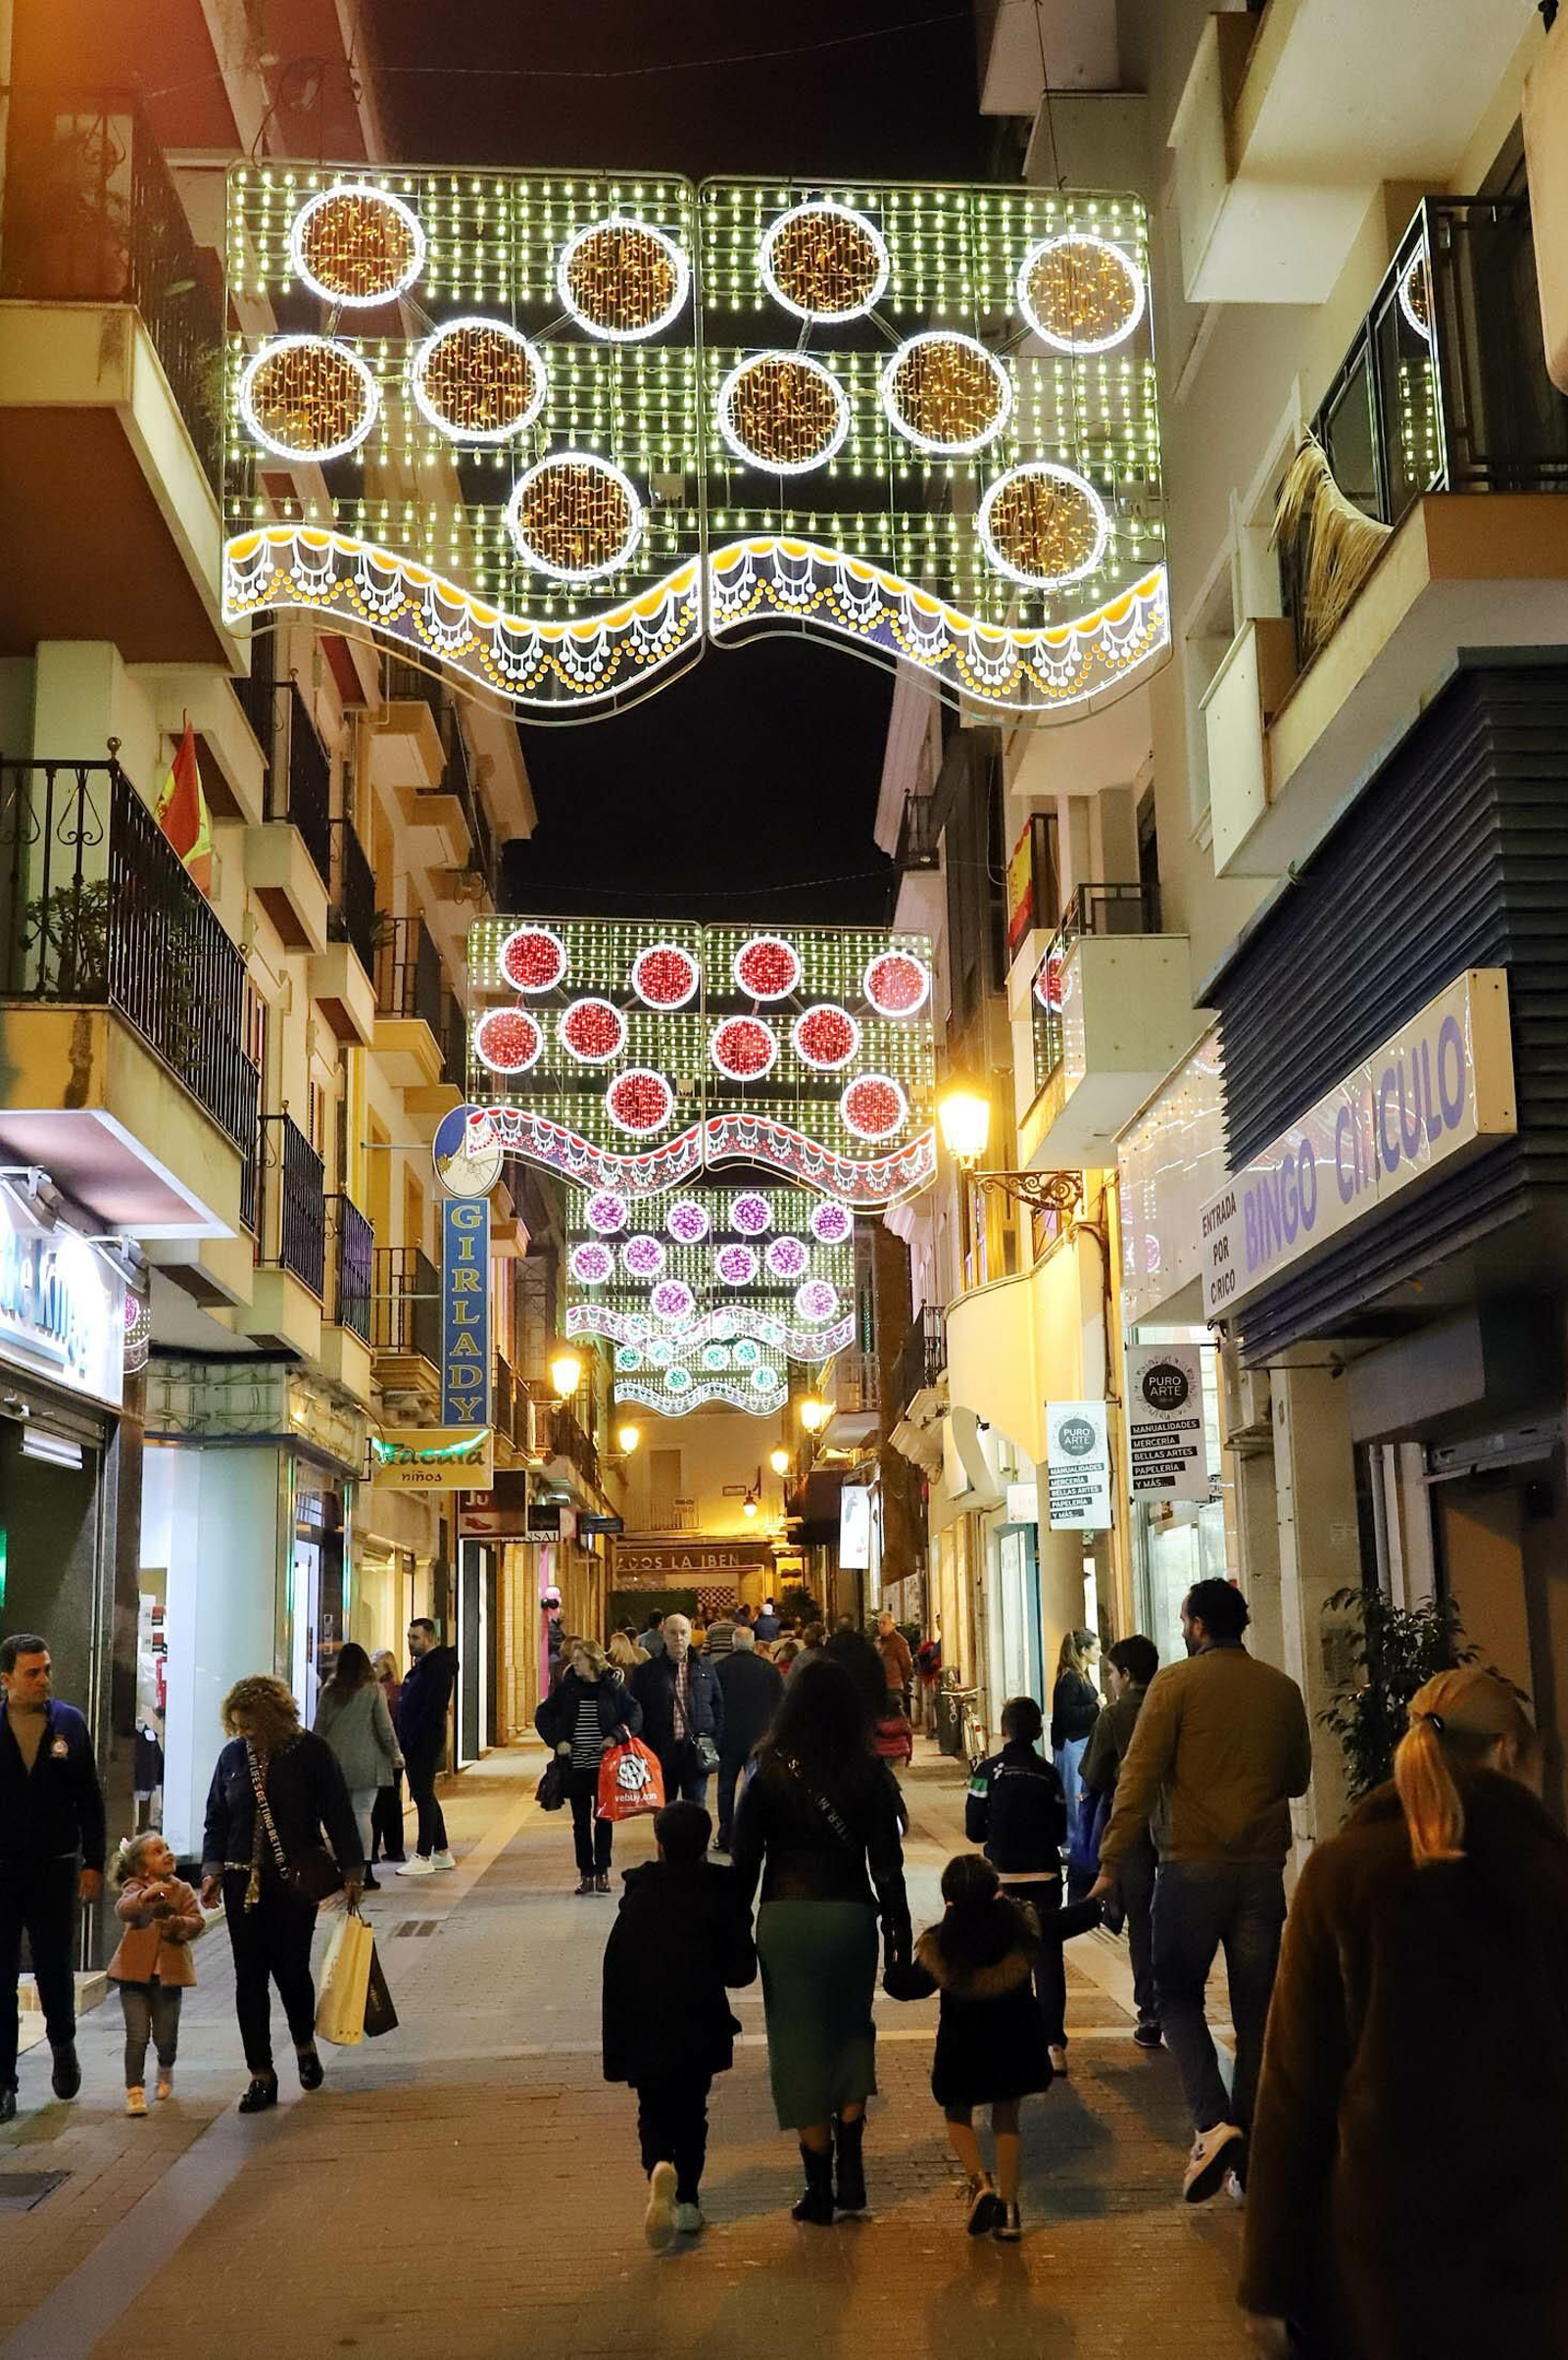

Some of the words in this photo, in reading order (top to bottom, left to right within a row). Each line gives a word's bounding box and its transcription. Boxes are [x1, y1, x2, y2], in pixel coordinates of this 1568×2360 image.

[1244, 1139, 1317, 1272] BINGO
[1202, 1192, 1237, 1238] ENTRADA
[1213, 1236, 1230, 1266] POR
[448, 1205, 483, 1421] GIRLADY
[1149, 1376, 1182, 1387] PURO
[1150, 1385, 1182, 1397] ARTE
[1063, 1428, 1090, 1437] PURO
[1132, 1420, 1198, 1434] MANUALIDADES
[1064, 1435, 1092, 1445] ARTE
[1133, 1436, 1176, 1448] MERCERÍA
[1134, 1450, 1165, 1461] BELLAS
[1166, 1448, 1194, 1457] ARTES
[1051, 1464, 1103, 1475] MANUALIDADES
[1135, 1463, 1180, 1476] PAPELERÍA
[402, 1471, 443, 1482] niños
[1136, 1480, 1142, 1489] Y
[1052, 1489, 1077, 1498] BELLAS
[1078, 1486, 1101, 1495] ARTES
[671, 1555, 694, 1568] LA
